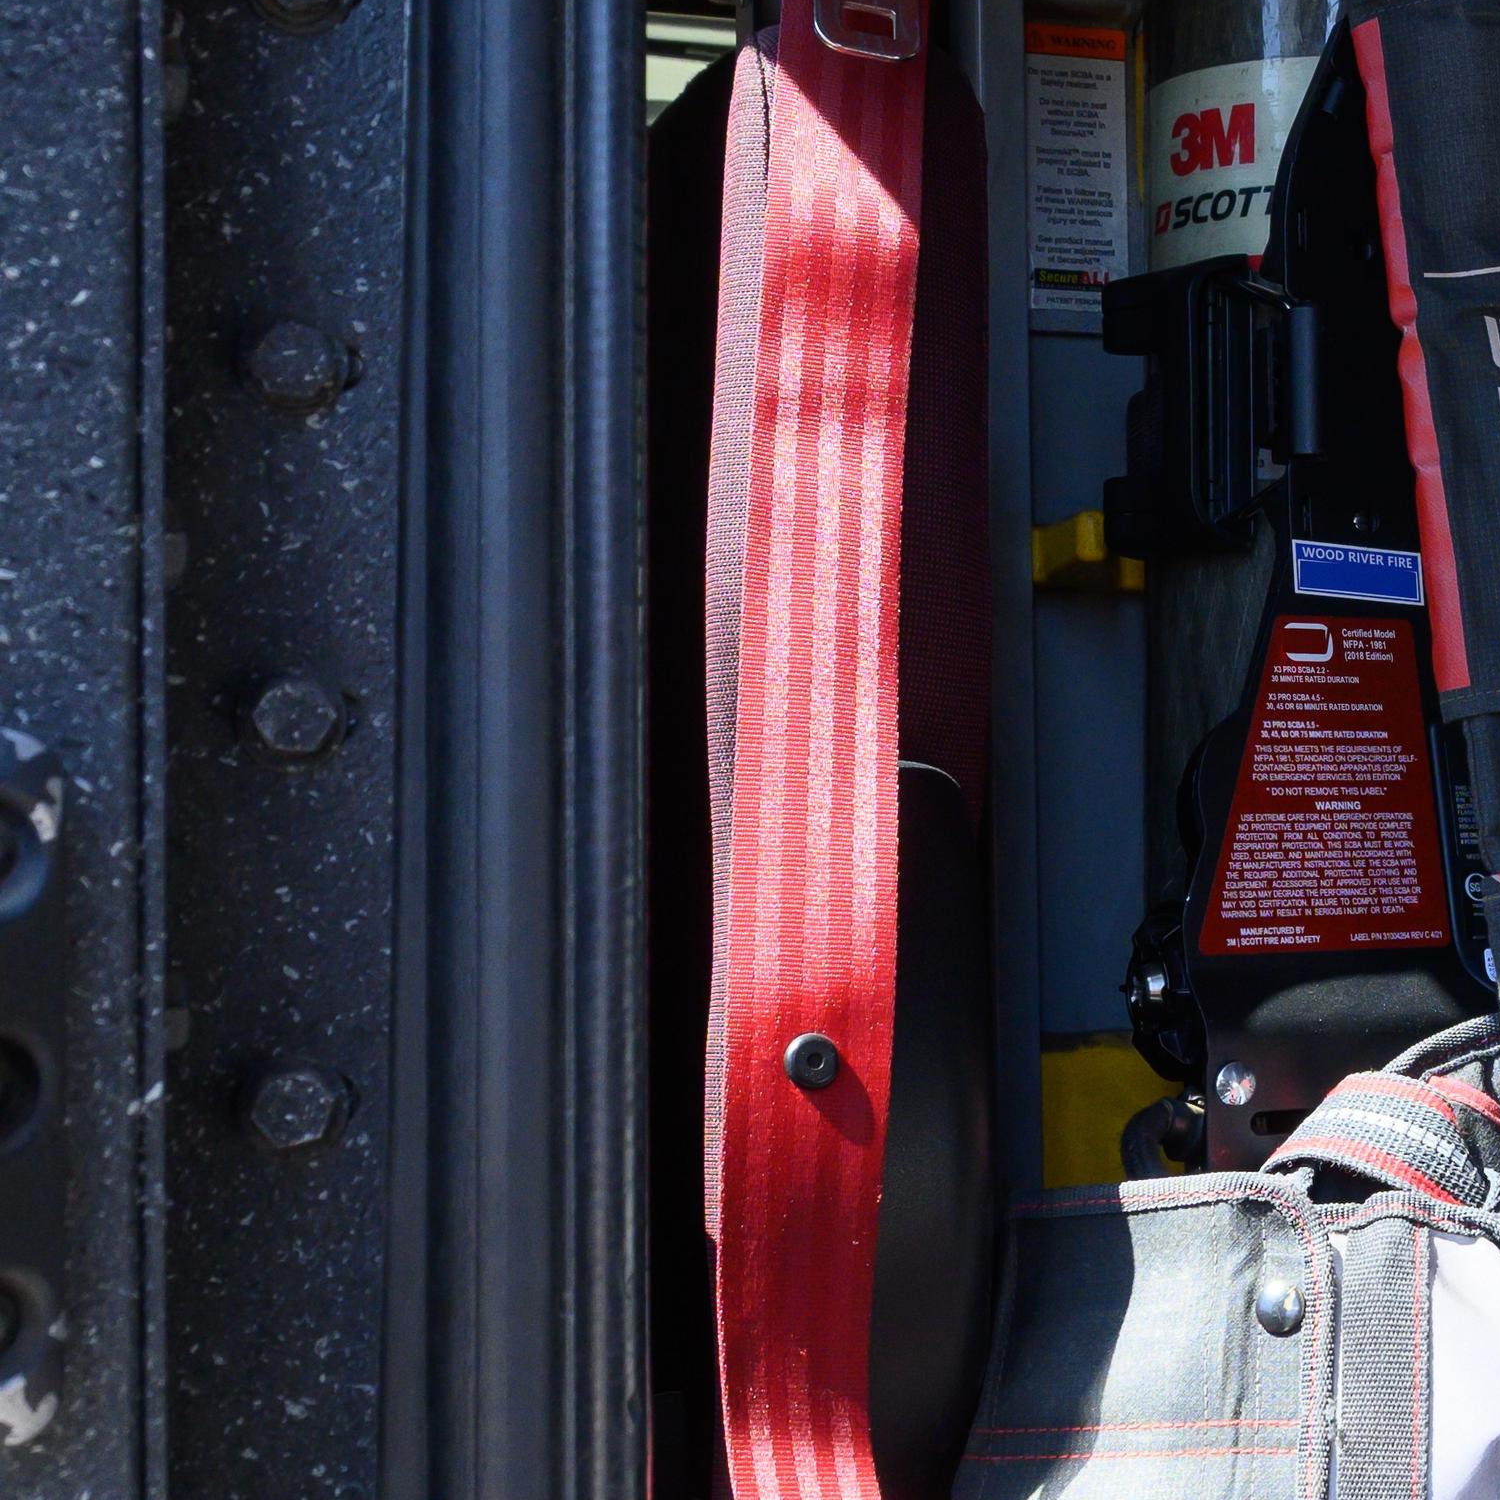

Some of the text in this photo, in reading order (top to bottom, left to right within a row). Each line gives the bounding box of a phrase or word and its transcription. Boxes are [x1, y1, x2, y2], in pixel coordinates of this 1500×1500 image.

[1050, 35, 1116, 50] WARNING
[1070, 70, 1093, 79] SCBA
[1076, 109, 1099, 118] SCBA
[1170, 103, 1255, 177] 3M
[1172, 185, 1275, 230] SCOTT
[1302, 546, 1413, 569] WOOD RIVER FIRE
[1341, 628, 1396, 639] Certified Model
[1343, 640, 1387, 649] NFPA 1981
[1344, 651, 1394, 663] (2018 Edition)
[1282, 666, 1296, 674] PRO
[1297, 666, 1315, 674] SCBA
[1316, 666, 1325, 674] 2.2
[1271, 675, 1360, 684] 30 MINUTE RATED DURATION
[1268, 693, 1320, 701] X3 PRO SCBA 4.5
[1284, 703, 1294, 711] OR
[1295, 703, 1303, 711] 60
[1303, 703, 1327, 711] MINUTE
[1328, 703, 1350, 711] RATED
[1350, 703, 1383, 711] DURATION
[1263, 721, 1315, 729] X3 PRO SCBA 5.5
[1281, 730, 1288, 738] 60
[1289, 730, 1299, 738] OR
[1300, 730, 1308, 738] 75
[1333, 731, 1355, 739] RATED
[1355, 731, 1388, 739] DURATION
[1255, 745, 1402, 754] THIS SCBA MEETS THE REQUIREMENTS OF
[1294, 755, 1333, 763] STANDARD
[1334, 755, 1346, 763] ON
[1397, 755, 1418, 763] SELF-
[1253, 764, 1407, 773] CONTAINED BREATHING APPARATUS (SCBA)
[1252, 773, 1268, 781] FOR
[1269, 773, 1314, 781] EMERGENCY
[1355, 773, 1371, 781] 2018
[1271, 787, 1284, 795] DO
[1285, 787, 1302, 796] NOT
[1304, 787, 1339, 796] REMOVE
[1341, 787, 1359, 796] THIS
[1315, 801, 1361, 810] WARNING
